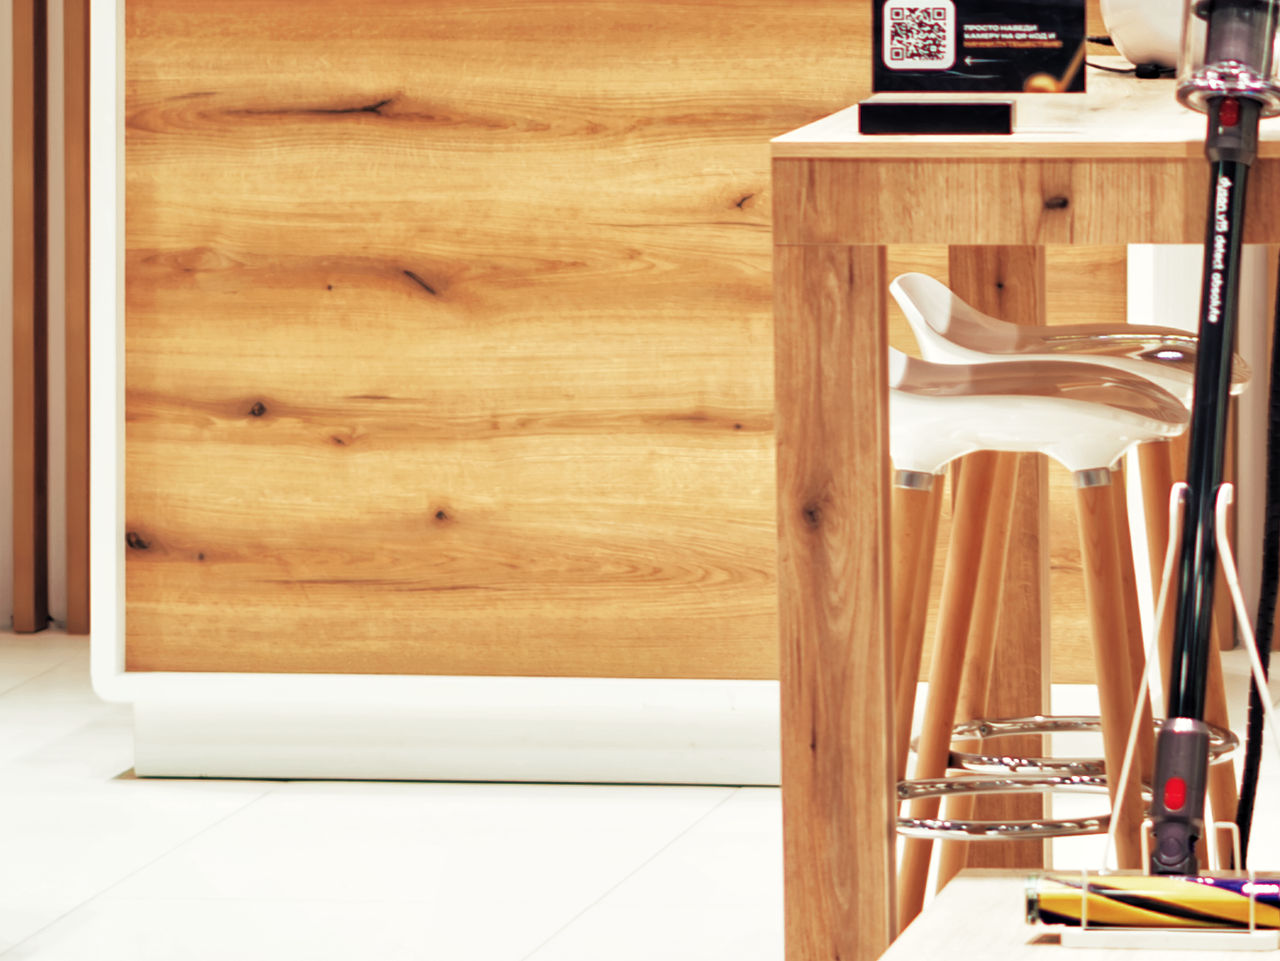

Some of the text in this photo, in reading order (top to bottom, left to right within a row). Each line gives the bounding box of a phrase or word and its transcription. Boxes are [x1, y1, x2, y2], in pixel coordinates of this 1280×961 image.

[1216, 177, 1233, 212] dyson
[1212, 234, 1228, 271] detect
[1208, 272, 1225, 323] absolute
